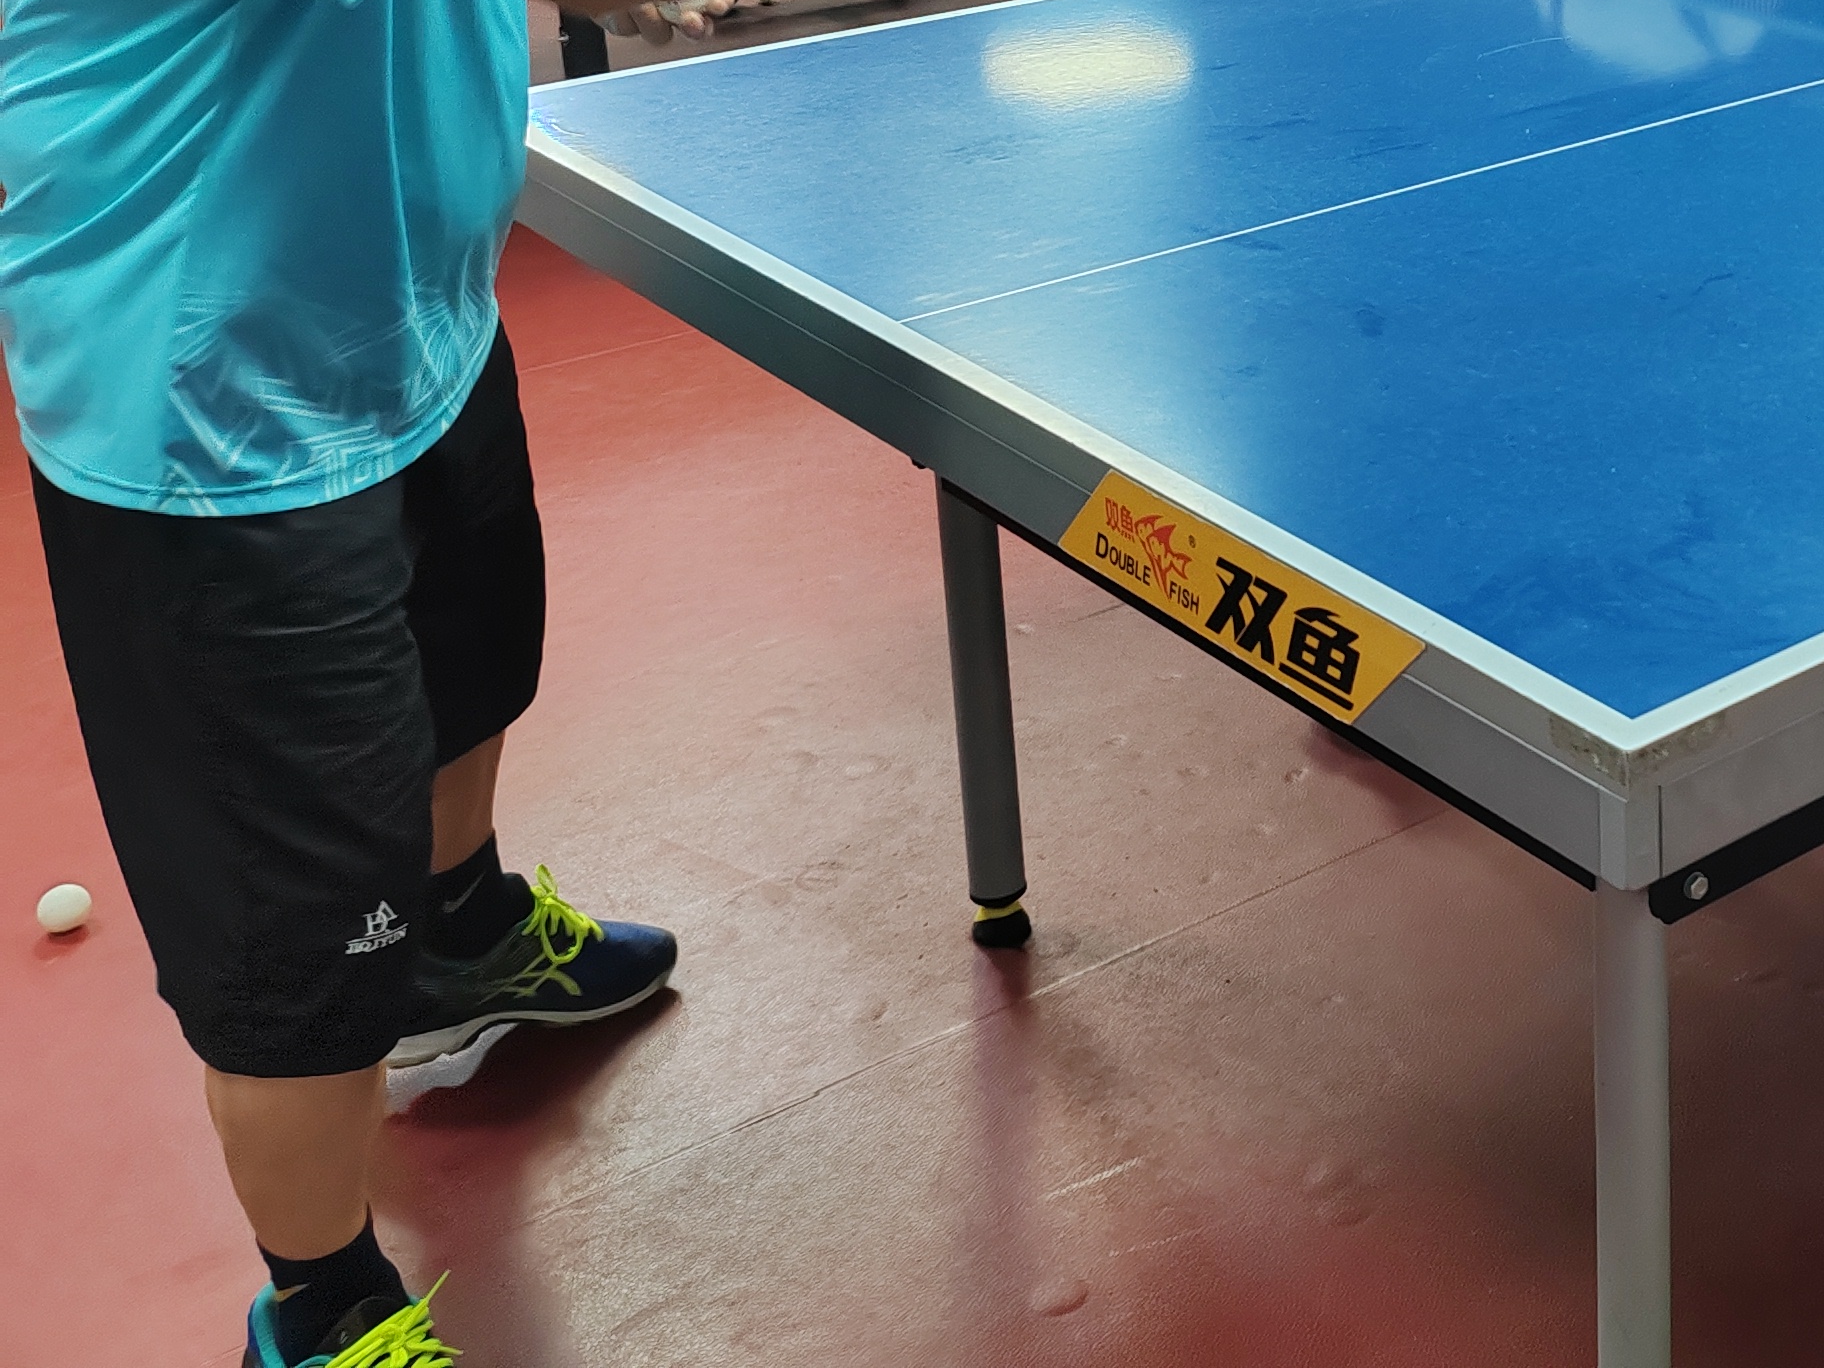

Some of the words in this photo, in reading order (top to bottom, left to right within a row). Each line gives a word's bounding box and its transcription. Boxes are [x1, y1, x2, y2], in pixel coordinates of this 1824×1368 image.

[1104, 497, 1136, 543] 双鱼
[1095, 531, 1152, 587] DOUBLE
[1168, 580, 1200, 616] FISH
[1204, 556, 1361, 712] 双鱼
